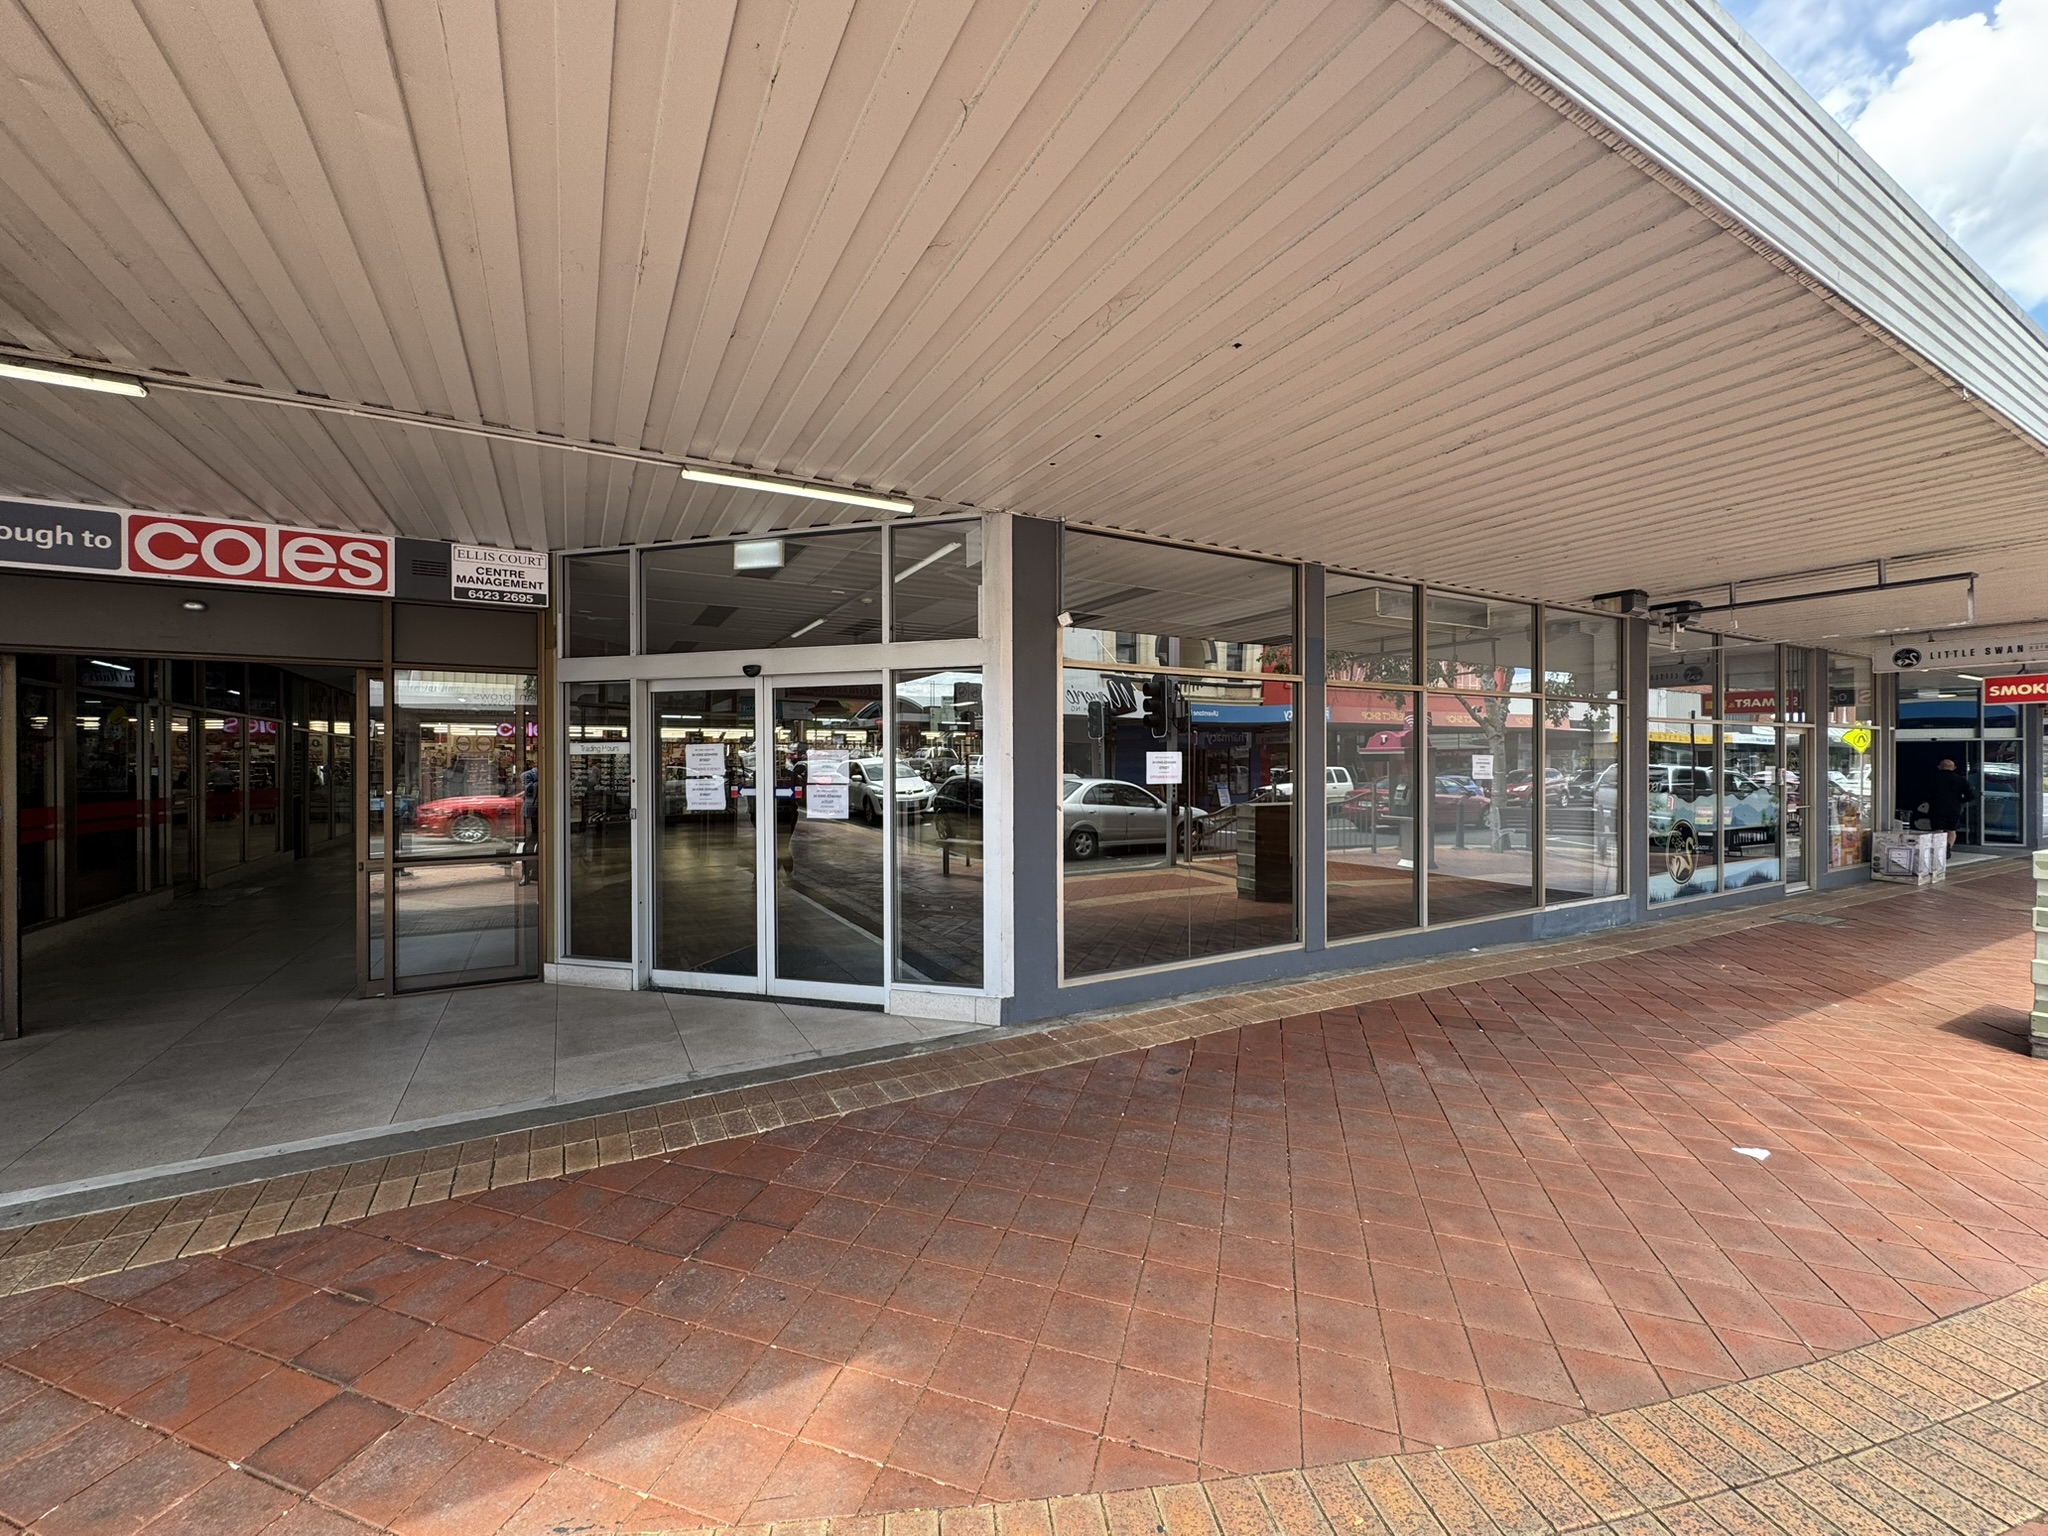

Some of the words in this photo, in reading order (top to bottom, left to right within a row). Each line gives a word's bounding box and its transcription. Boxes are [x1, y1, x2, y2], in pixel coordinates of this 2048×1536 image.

[81, 530, 112, 549] to
[134, 522, 383, 586] coles
[457, 549, 495, 562] ELLIS
[499, 553, 544, 567] COURT
[476, 566, 526, 579] CENTRE
[456, 574, 544, 590] MANAGEMENT
[468, 589, 500, 599] 6423
[503, 592, 534, 603] 2695
[1930, 648, 1975, 660] LITTLE
[1985, 645, 2024, 656] SWAN
[580, 744, 601, 753] Trading
[602, 744, 620, 752] Hours
